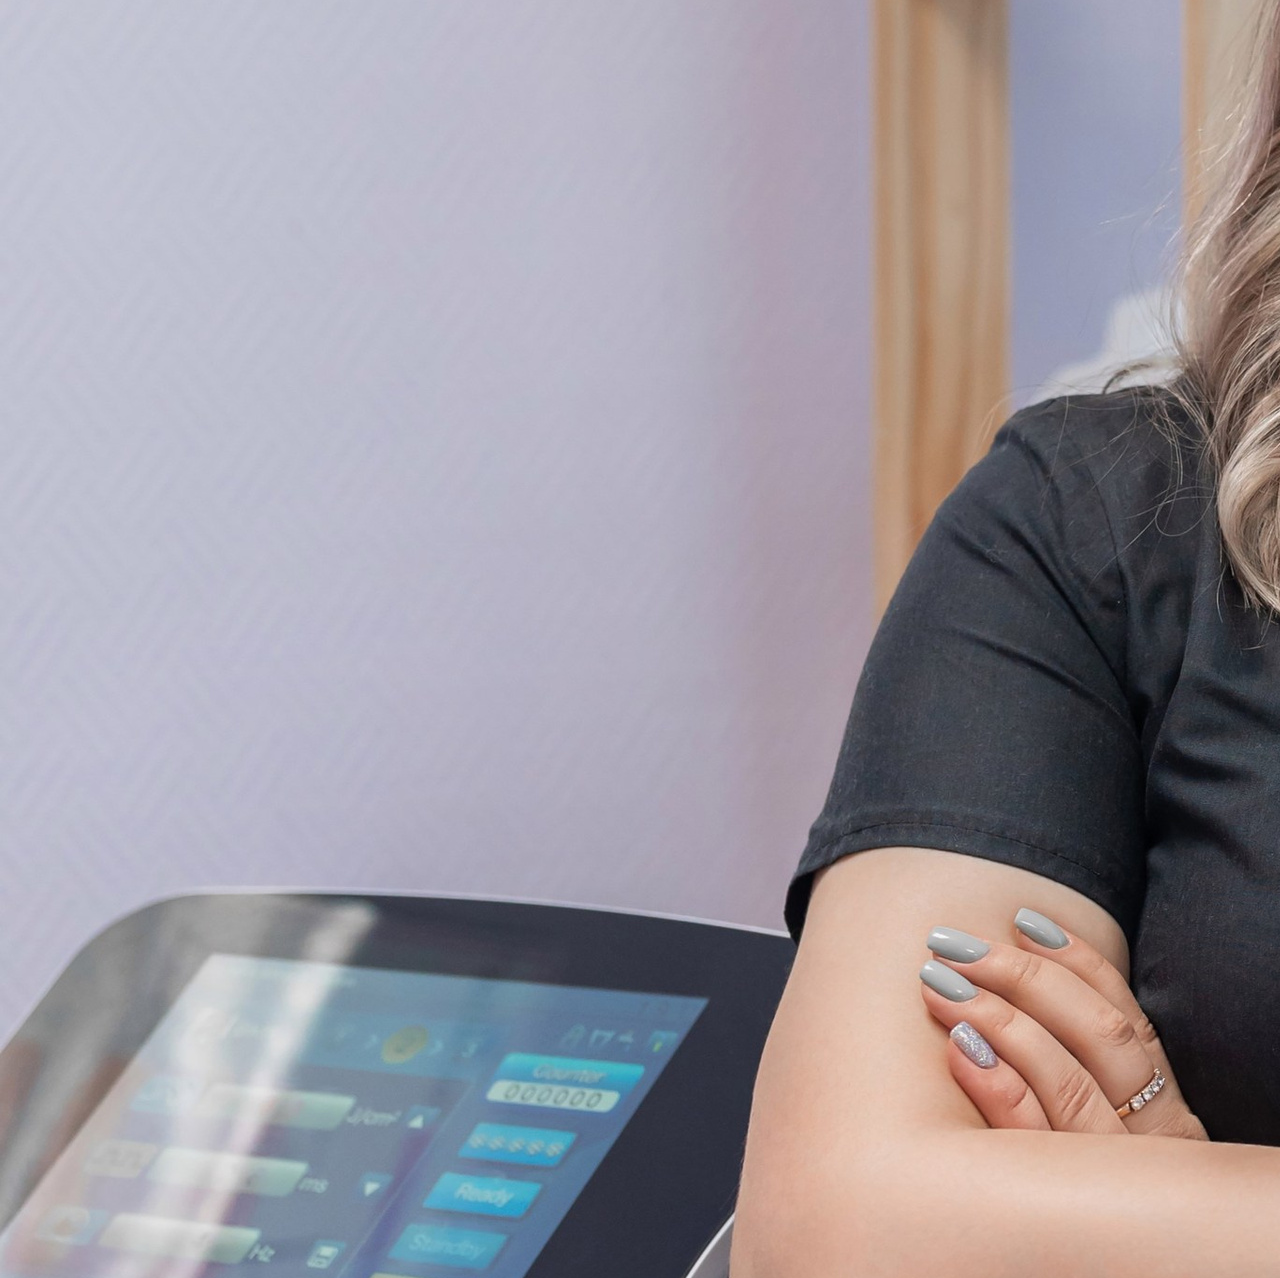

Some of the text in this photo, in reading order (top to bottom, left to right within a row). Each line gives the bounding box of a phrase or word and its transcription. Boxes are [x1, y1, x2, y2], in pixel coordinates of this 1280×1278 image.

[533, 1063, 607, 1083] Counter
[503, 1083, 603, 1109] 000000
[454, 1182, 515, 1208] Ready
[249, 1244, 276, 1263] Hz
[408, 1233, 487, 1261] Standby
